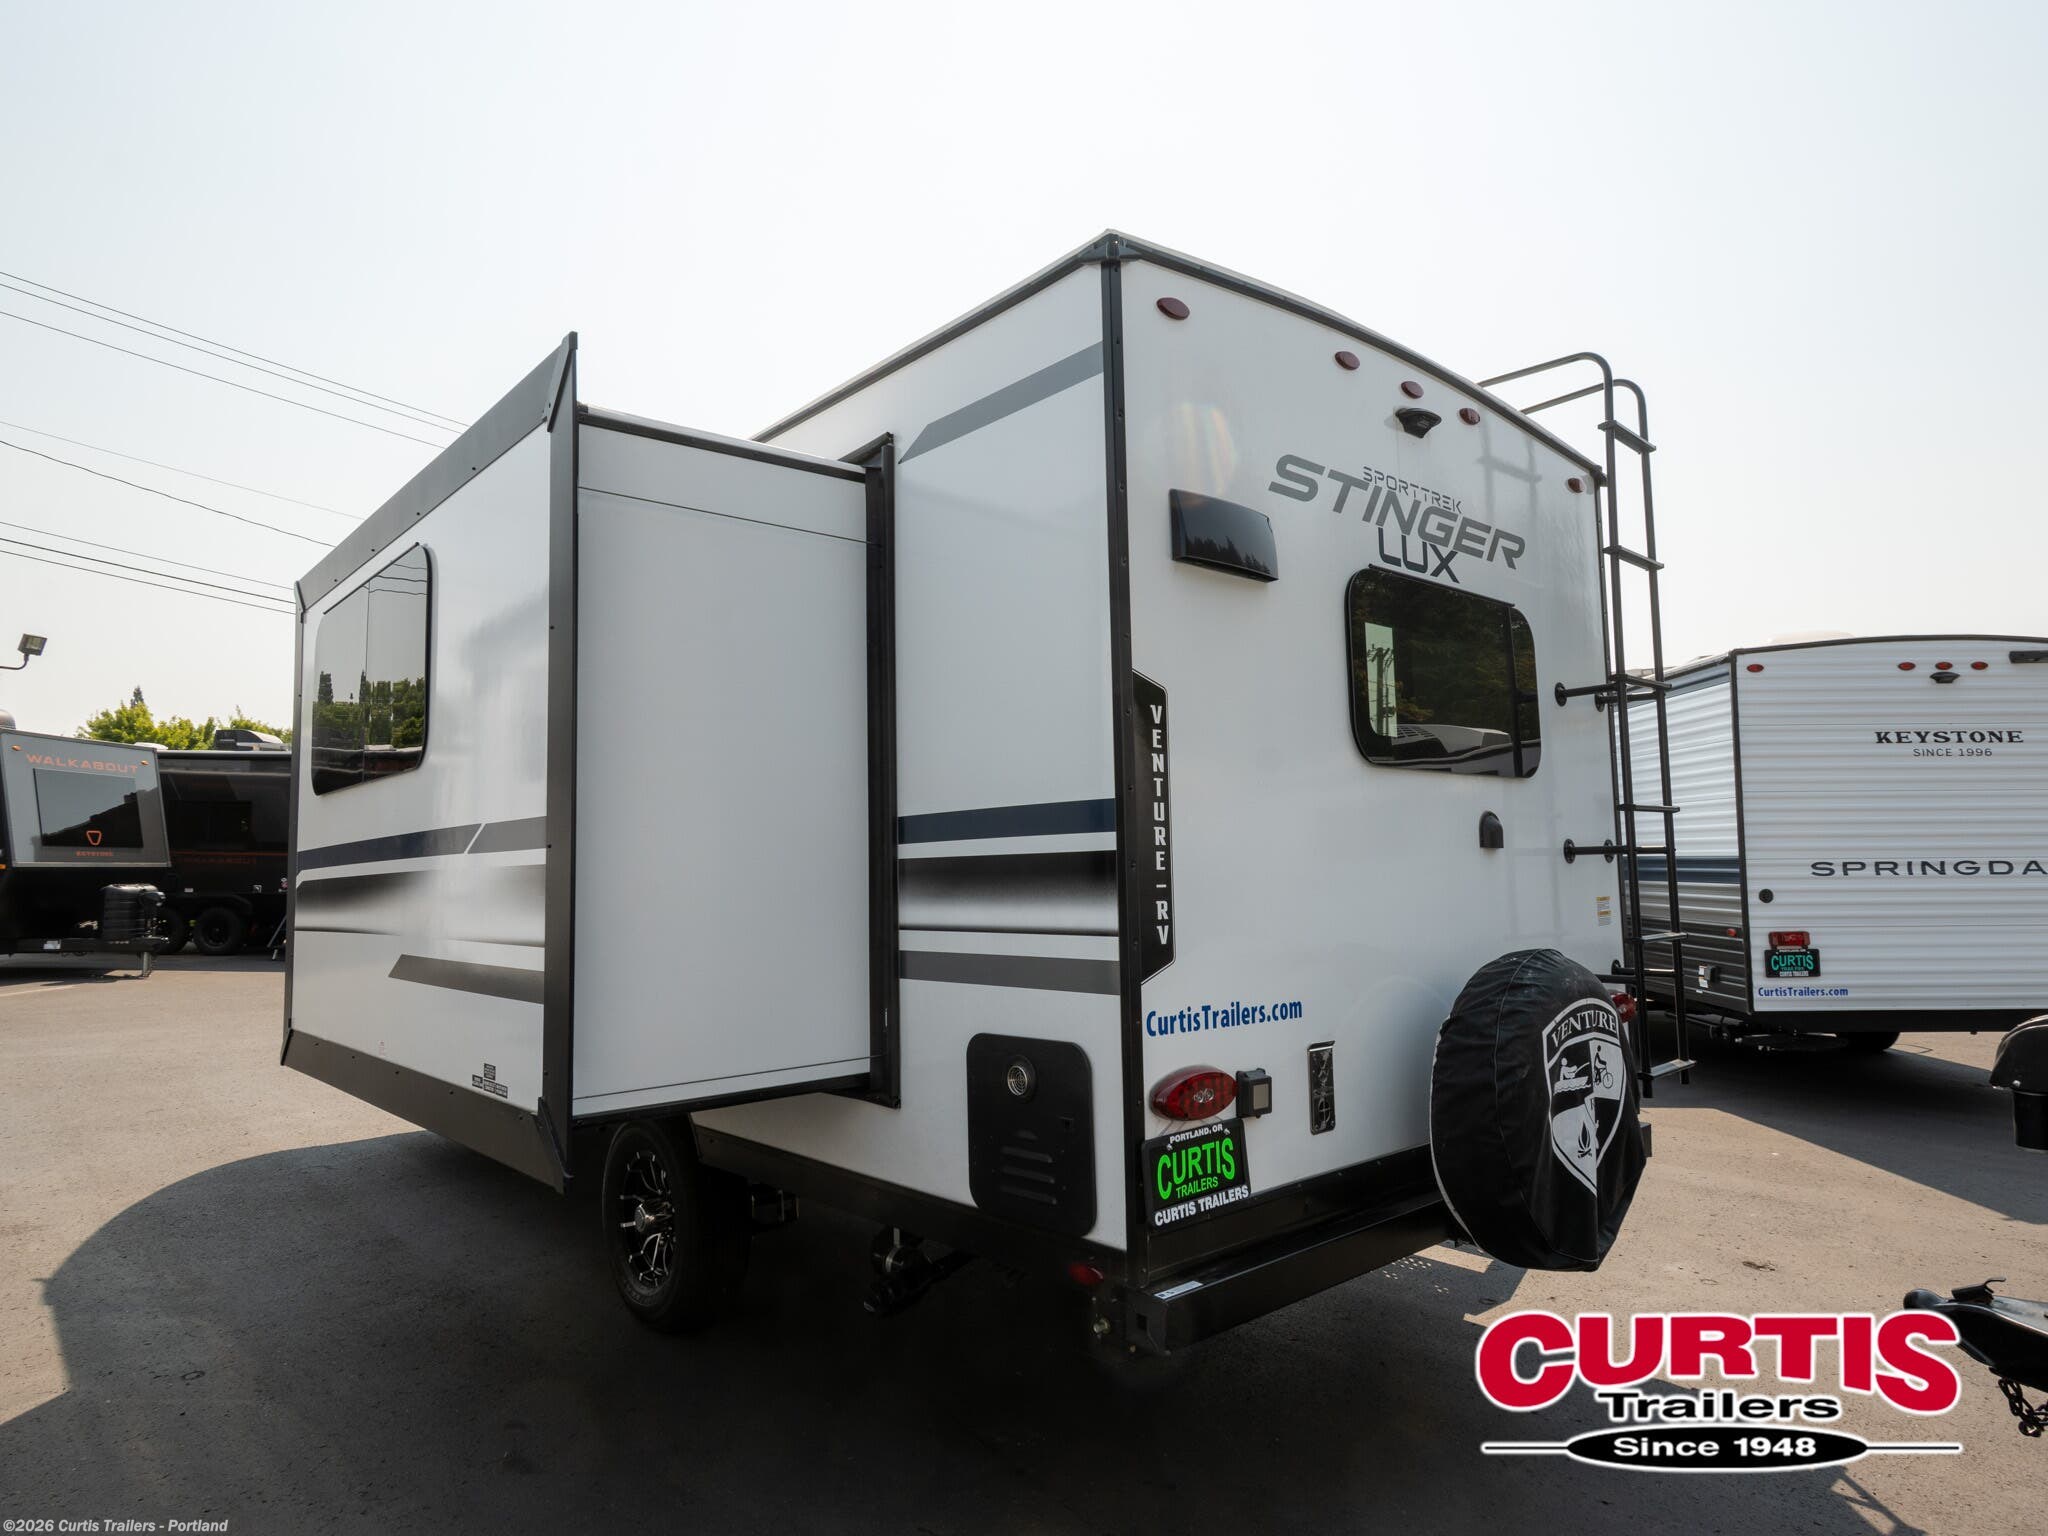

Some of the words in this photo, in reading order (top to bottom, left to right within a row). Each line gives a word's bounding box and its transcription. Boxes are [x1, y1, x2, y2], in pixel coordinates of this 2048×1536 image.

[1362, 466, 1462, 514] SPORTTREK
[1268, 454, 1526, 570] STINGER
[1378, 527, 1460, 584] LUX
[1875, 730, 2024, 744] KEYSTONE
[26, 753, 138, 774] WALKABOUT
[1913, 748, 1953, 757] SINCE
[1959, 748, 1993, 757] 1996
[1810, 860, 2048, 877] SPRINGDA
[1771, 954, 1814, 971] CURTIS
[1758, 986, 1849, 997] CurtisTrailers.com
[1146, 1001, 1303, 1037] CurtisTrailers.com
[1552, 1010, 1617, 1047] VENTURE
[1169, 1127, 1212, 1144] PORTLAND,
[1212, 1124, 1223, 1133] OR
[1157, 1137, 1236, 1200] CURTIS
[1176, 1176, 1219, 1199] TRAILERS
[1154, 1201, 1196, 1226] CURTIS
[1198, 1185, 1249, 1212] TRAILERS
